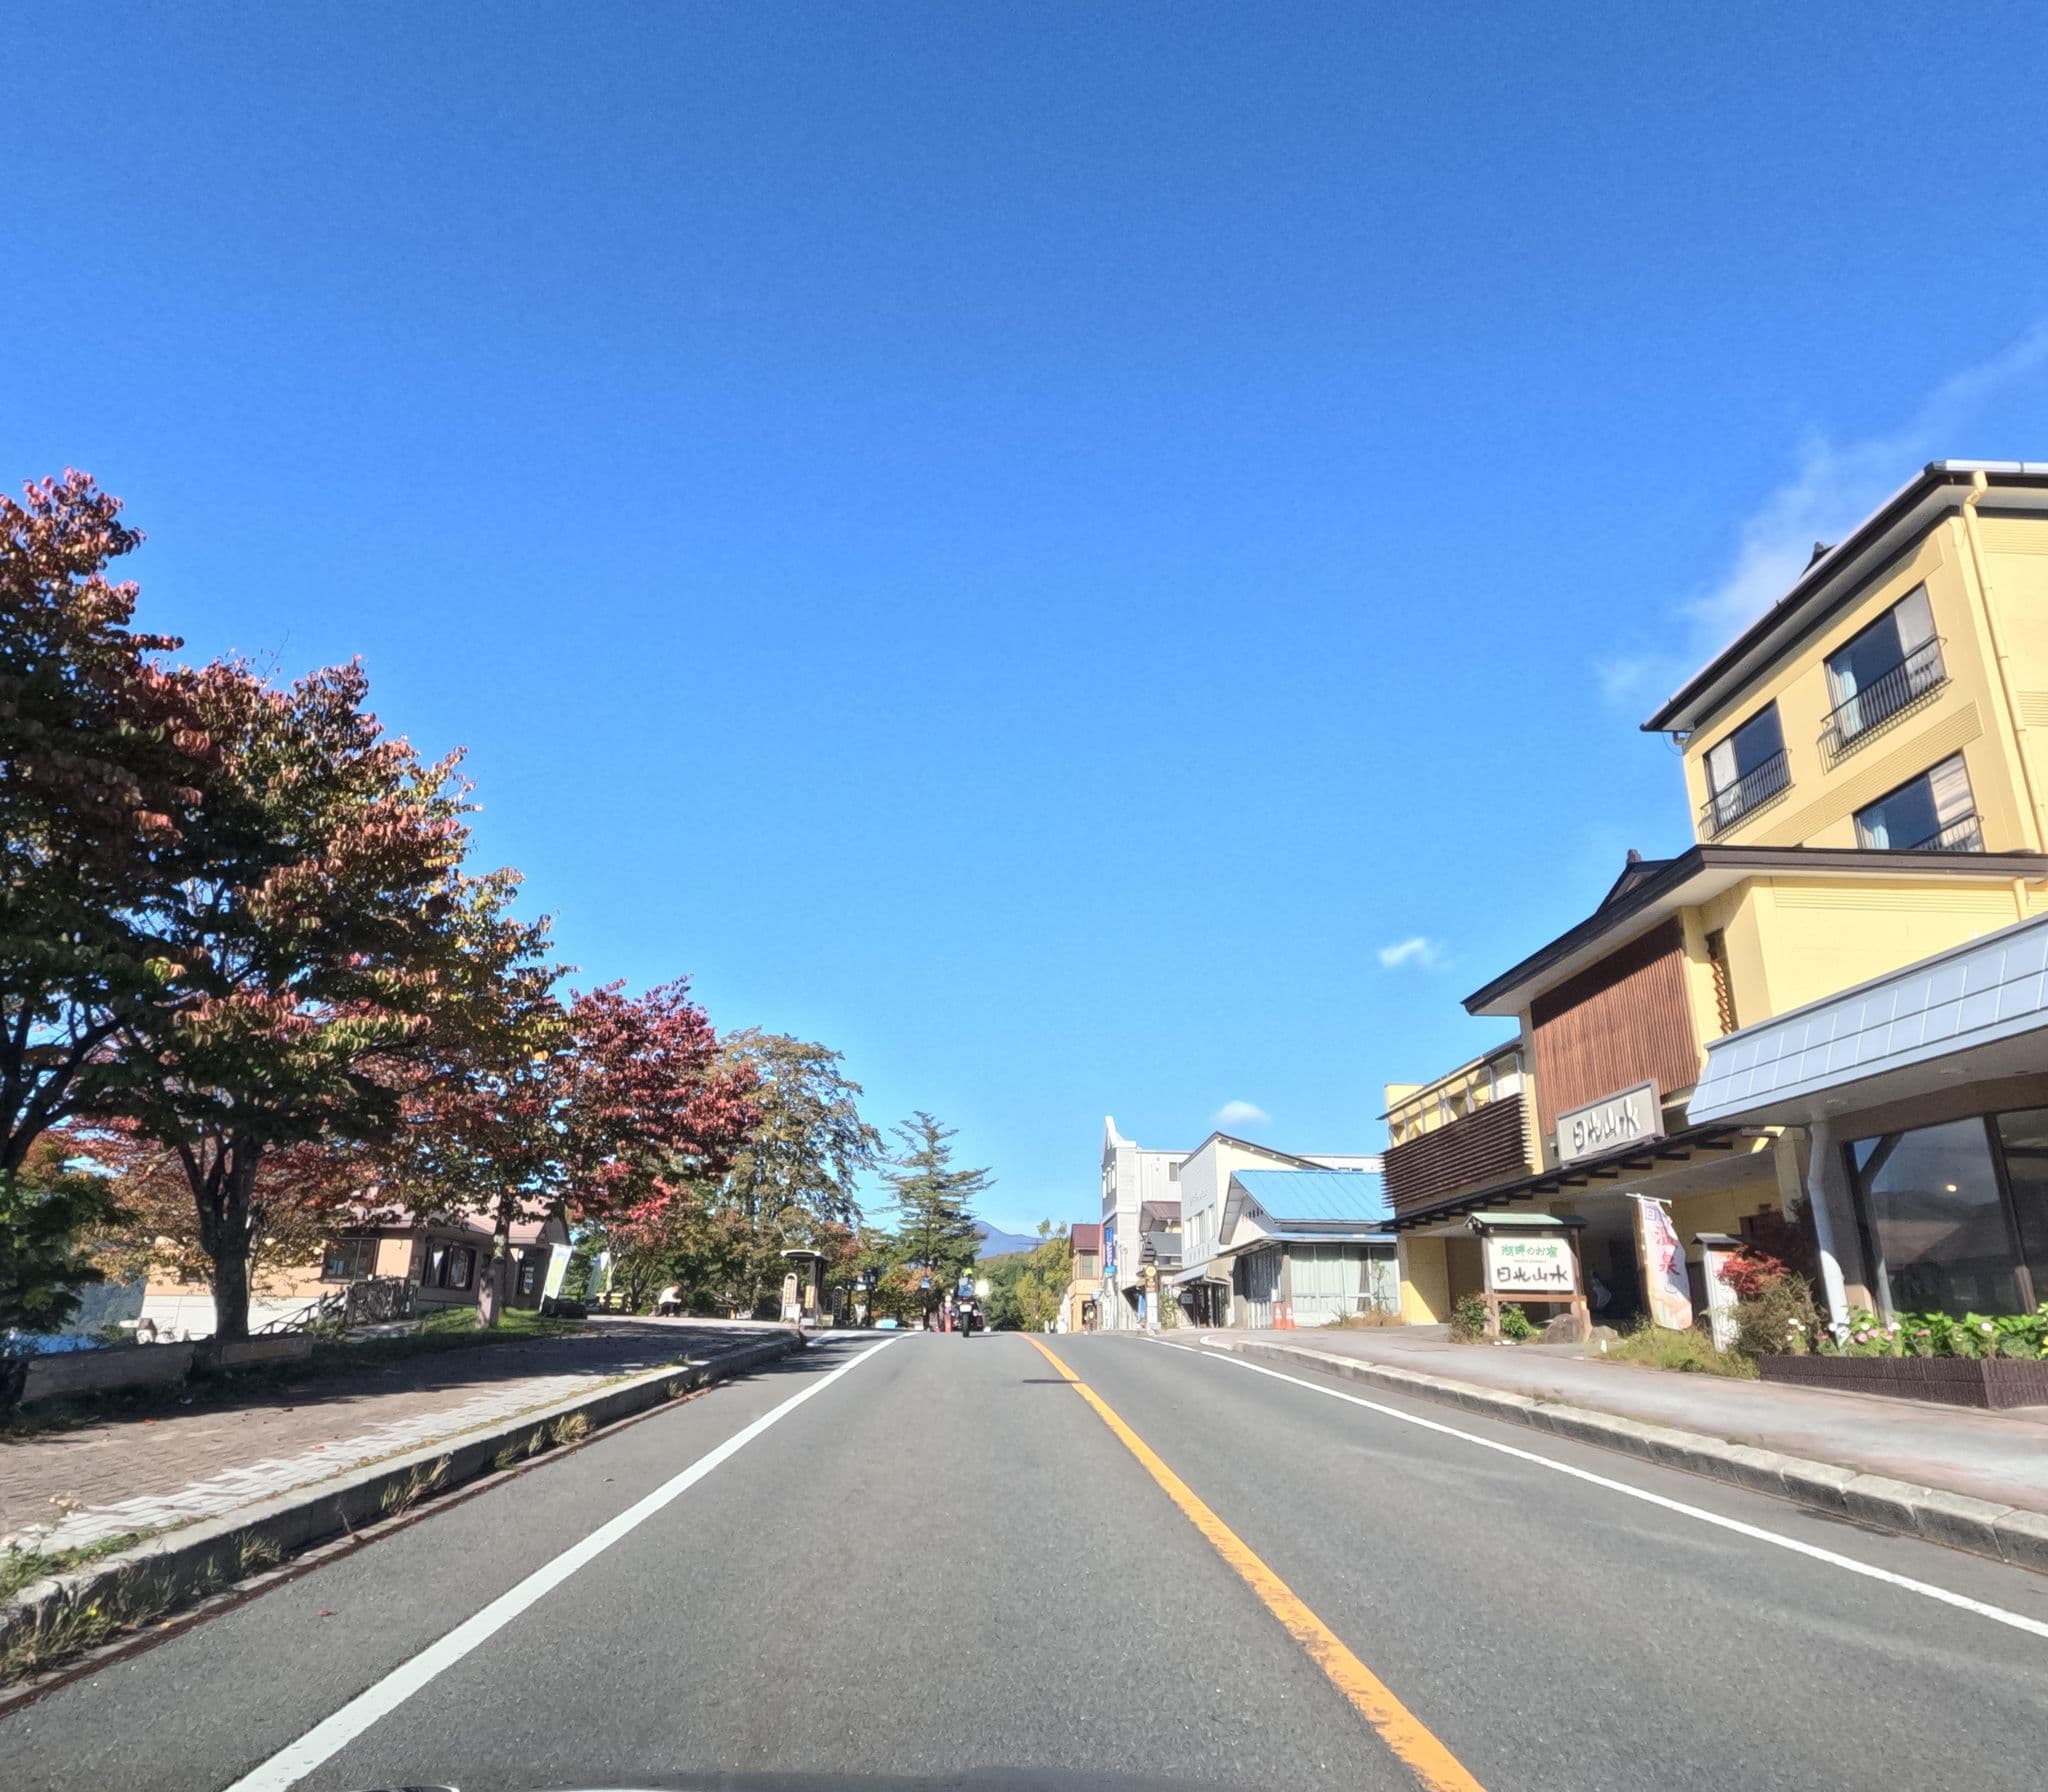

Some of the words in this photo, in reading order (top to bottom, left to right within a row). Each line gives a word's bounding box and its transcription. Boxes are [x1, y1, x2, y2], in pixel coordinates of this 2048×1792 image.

[1573, 1097, 1641, 1153] 日光山水
[1501, 1244, 1558, 1258] 湖畔のお宿
[1497, 1264, 1568, 1284] 日光山水
